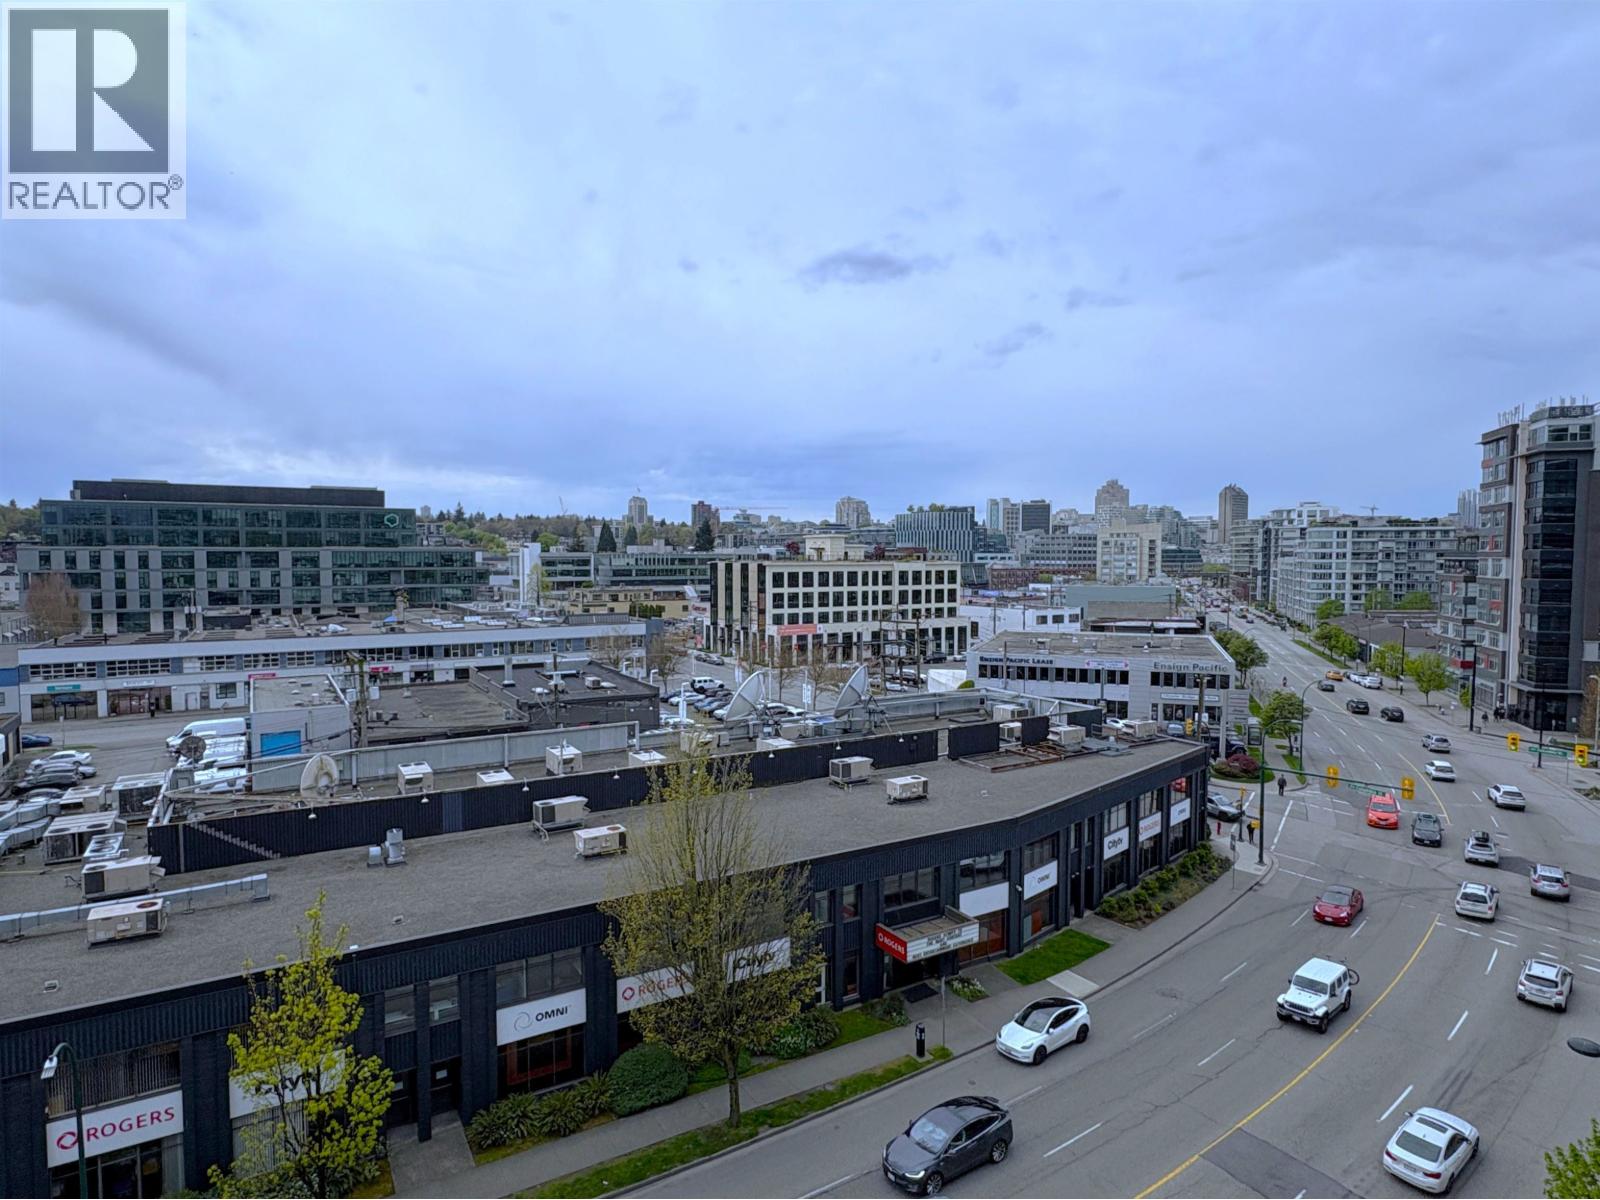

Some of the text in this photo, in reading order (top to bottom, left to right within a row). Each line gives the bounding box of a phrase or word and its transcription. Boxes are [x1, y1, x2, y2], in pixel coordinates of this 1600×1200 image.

[1153, 661, 1228, 673] Ensign Pacific
[883, 935, 906, 955] ROGERS
[535, 1006, 568, 1022] OMNI
[86, 1107, 175, 1142] ROGERS
